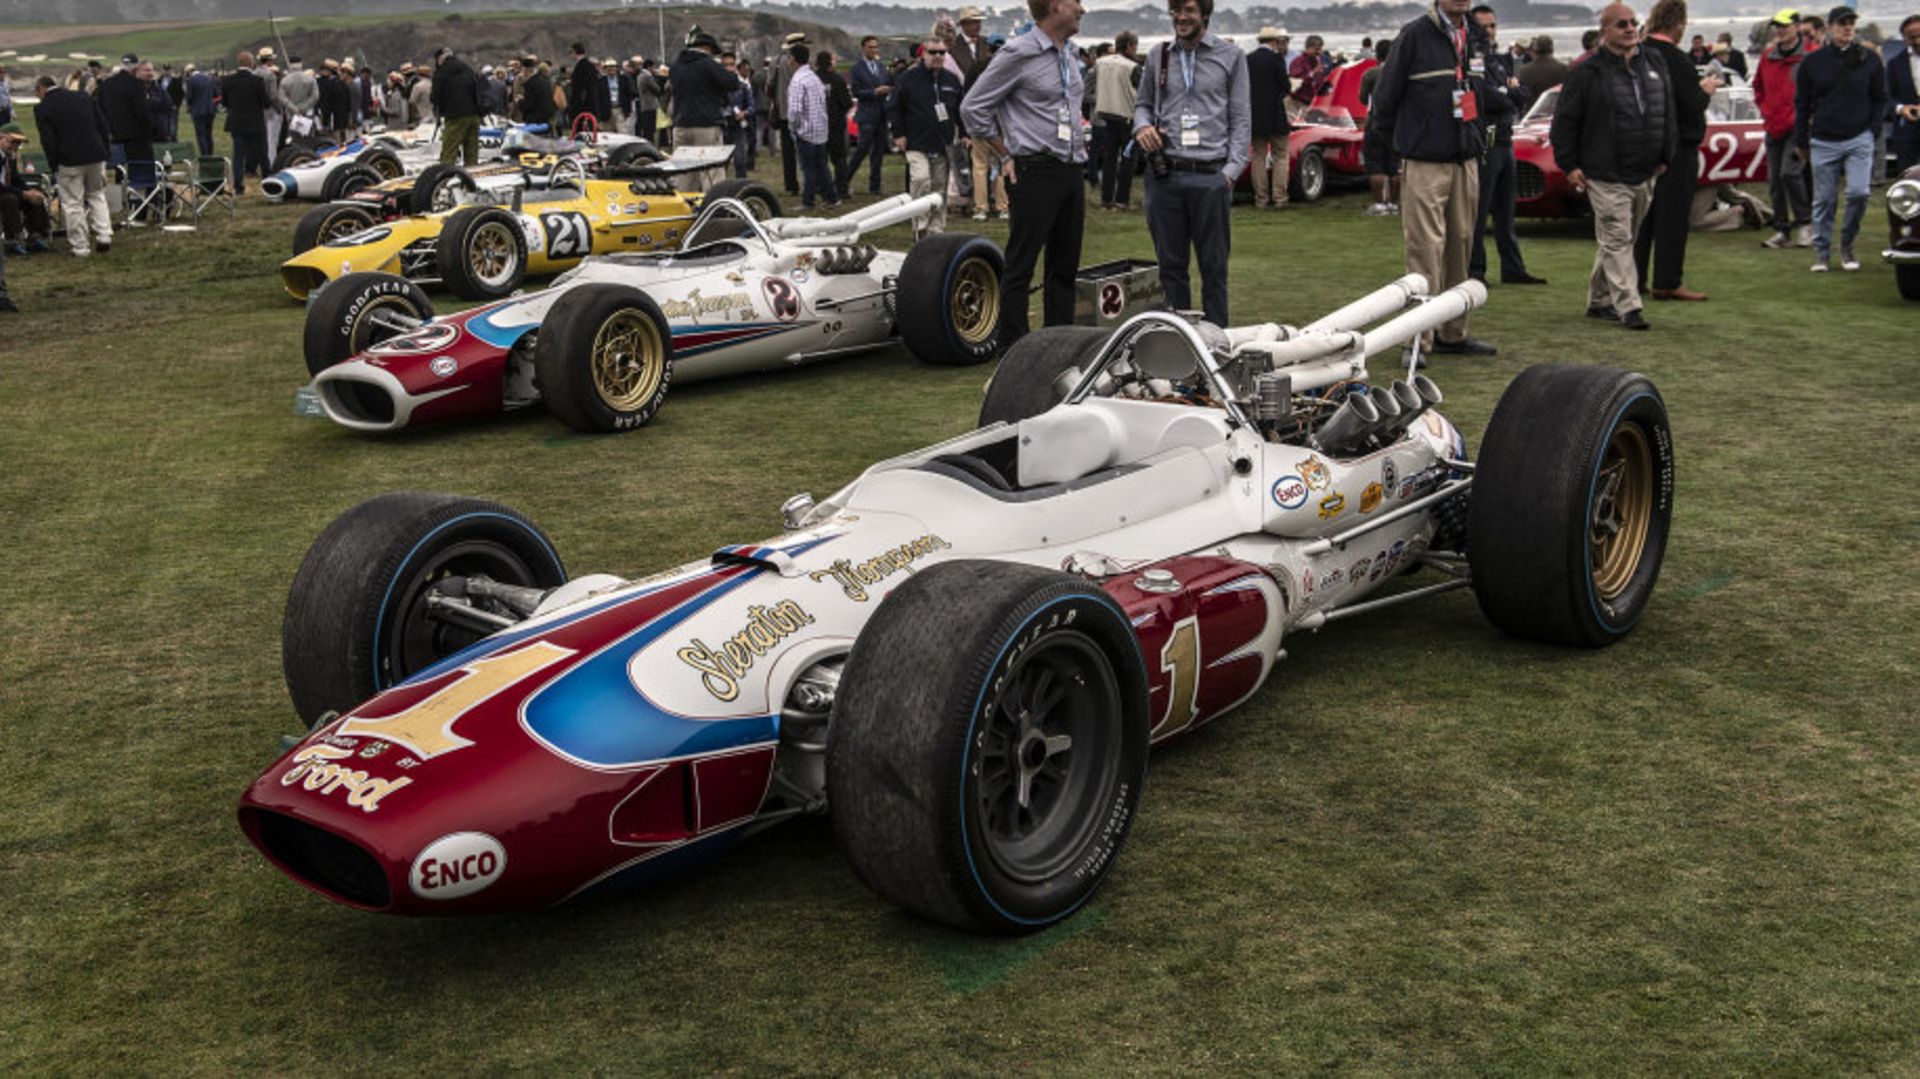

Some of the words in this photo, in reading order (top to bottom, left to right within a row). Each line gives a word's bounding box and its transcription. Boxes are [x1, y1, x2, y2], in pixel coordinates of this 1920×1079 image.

[1697, 132, 1766, 180] 27
[546, 212, 590, 256] 21
[340, 281, 410, 337] GOODYEAR
[767, 279, 798, 319] 2
[1101, 283, 1122, 315] 2
[810, 533, 952, 602] Thompson
[676, 598, 816, 702] Sheraton
[337, 640, 577, 761] 1
[1150, 614, 1201, 744] 1
[280, 744, 414, 813] Ford
[419, 851, 497, 890] ENCO
